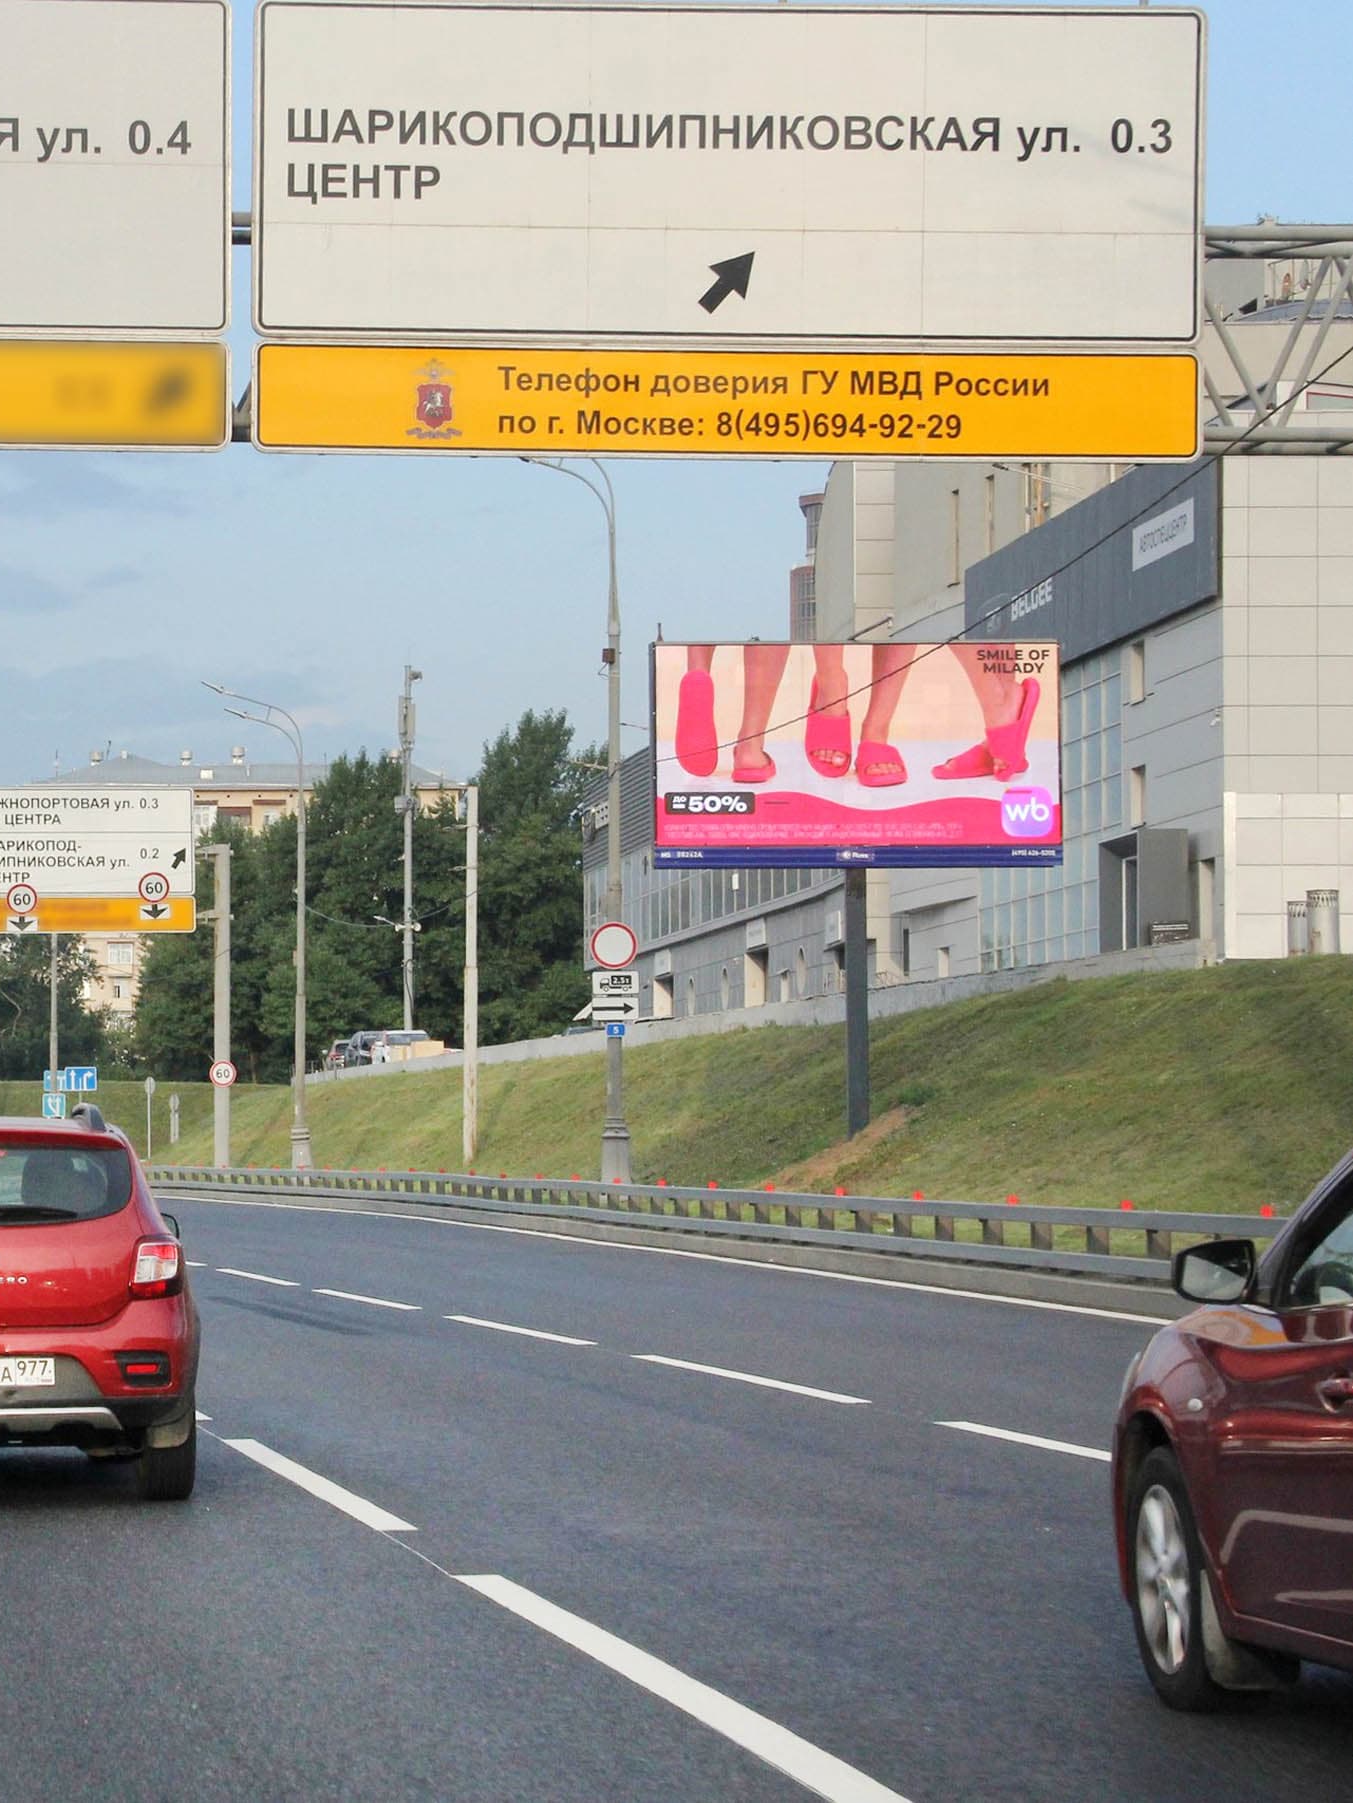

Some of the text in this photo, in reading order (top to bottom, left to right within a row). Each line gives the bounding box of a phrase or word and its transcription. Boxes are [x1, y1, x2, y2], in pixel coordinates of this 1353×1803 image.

[36, 127, 102, 163] ул.
[128, 119, 192, 155] 0.4
[287, 108, 1172, 162] ШАРИКОПОДШИПНИКОВСКАЯ ул. 0.3
[287, 162, 441, 205] ЦЕНТР
[498, 367, 1049, 401] Телефон доверия ГУ МВД России
[498, 409, 962, 441] по г. Москве: 8(495)694-92-29
[976, 649, 1050, 661] SMILE OF
[983, 662, 1044, 674] MILADY
[114, 800, 135, 812] ул.
[139, 798, 159, 809] 0.3
[688, 795, 748, 813] 50%
[1005, 796, 1050, 822] wb
[5, 813, 61, 827] ЦЕНТРА
[139, 848, 160, 860] 0.2
[110, 858, 130, 870] ул.
[145, 882, 164, 894] 60
[13, 893, 31, 906] 60
[216, 1068, 230, 1079] 60
